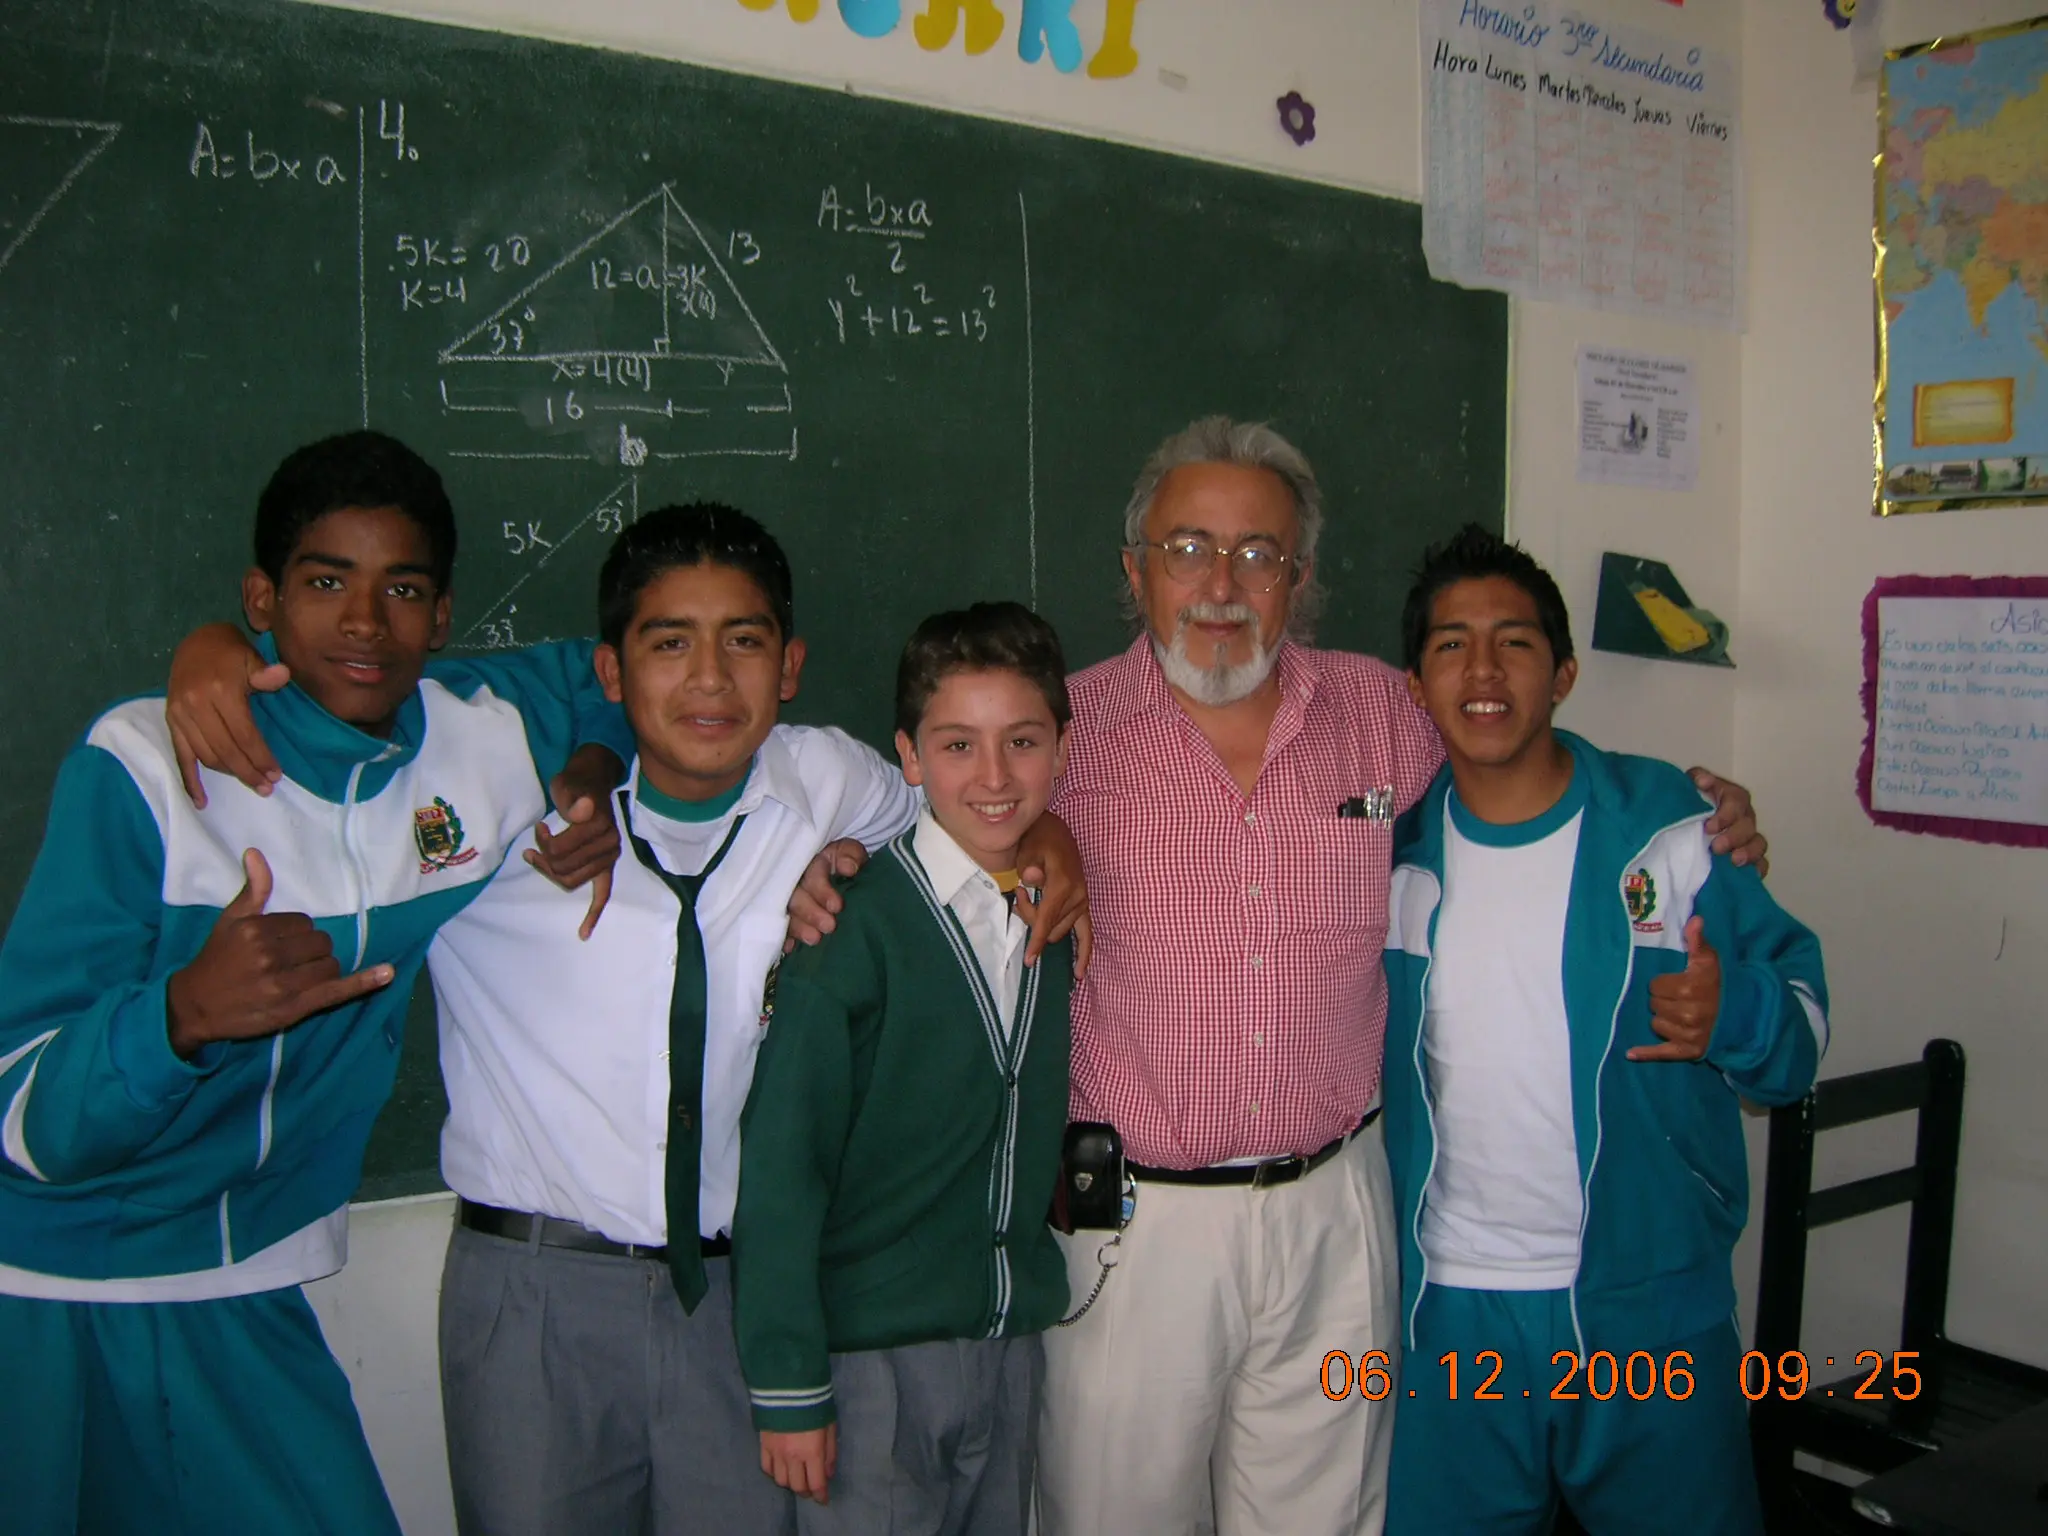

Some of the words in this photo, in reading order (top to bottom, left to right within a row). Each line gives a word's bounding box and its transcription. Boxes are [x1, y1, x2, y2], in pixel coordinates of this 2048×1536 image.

[1433, 38, 1478, 73] Hora
[1485, 54, 1527, 92] Lunes
[1539, 73, 1580, 105] Martes
[1594, 34, 1705, 92] Secundaria
[728, 230, 761, 265] 13
[887, 241, 906, 273] 2
[546, 390, 584, 425] 16
